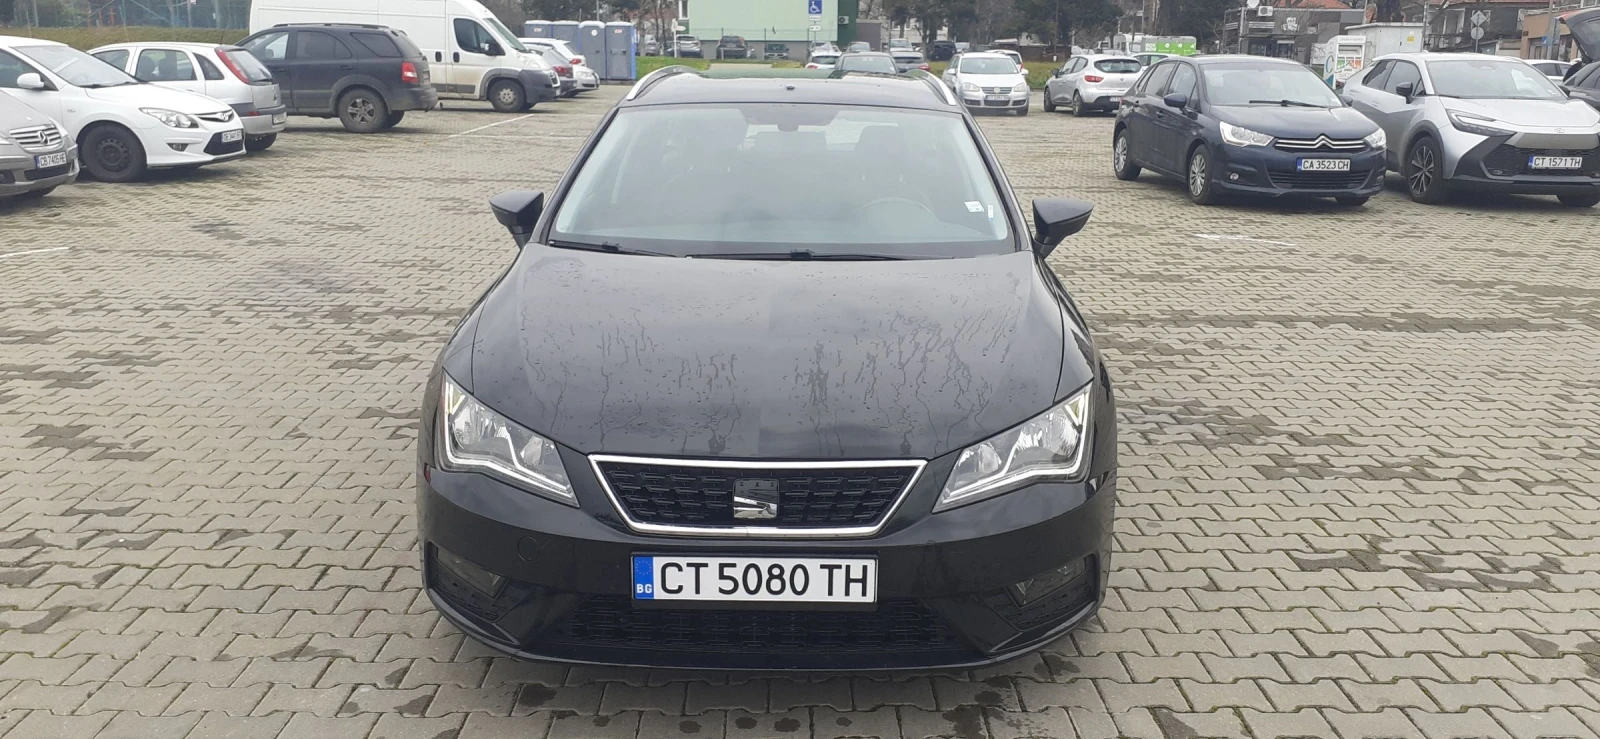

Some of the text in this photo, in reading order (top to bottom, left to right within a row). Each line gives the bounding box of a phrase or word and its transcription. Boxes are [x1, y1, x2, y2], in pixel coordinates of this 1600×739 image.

[40, 156, 47, 167] CB
[1302, 160, 1349, 170] CA 3523 CH
[1533, 157, 1581, 167] CT 1571 TH
[660, 562, 869, 597] CT 5080 TH
[636, 583, 652, 594] BG
